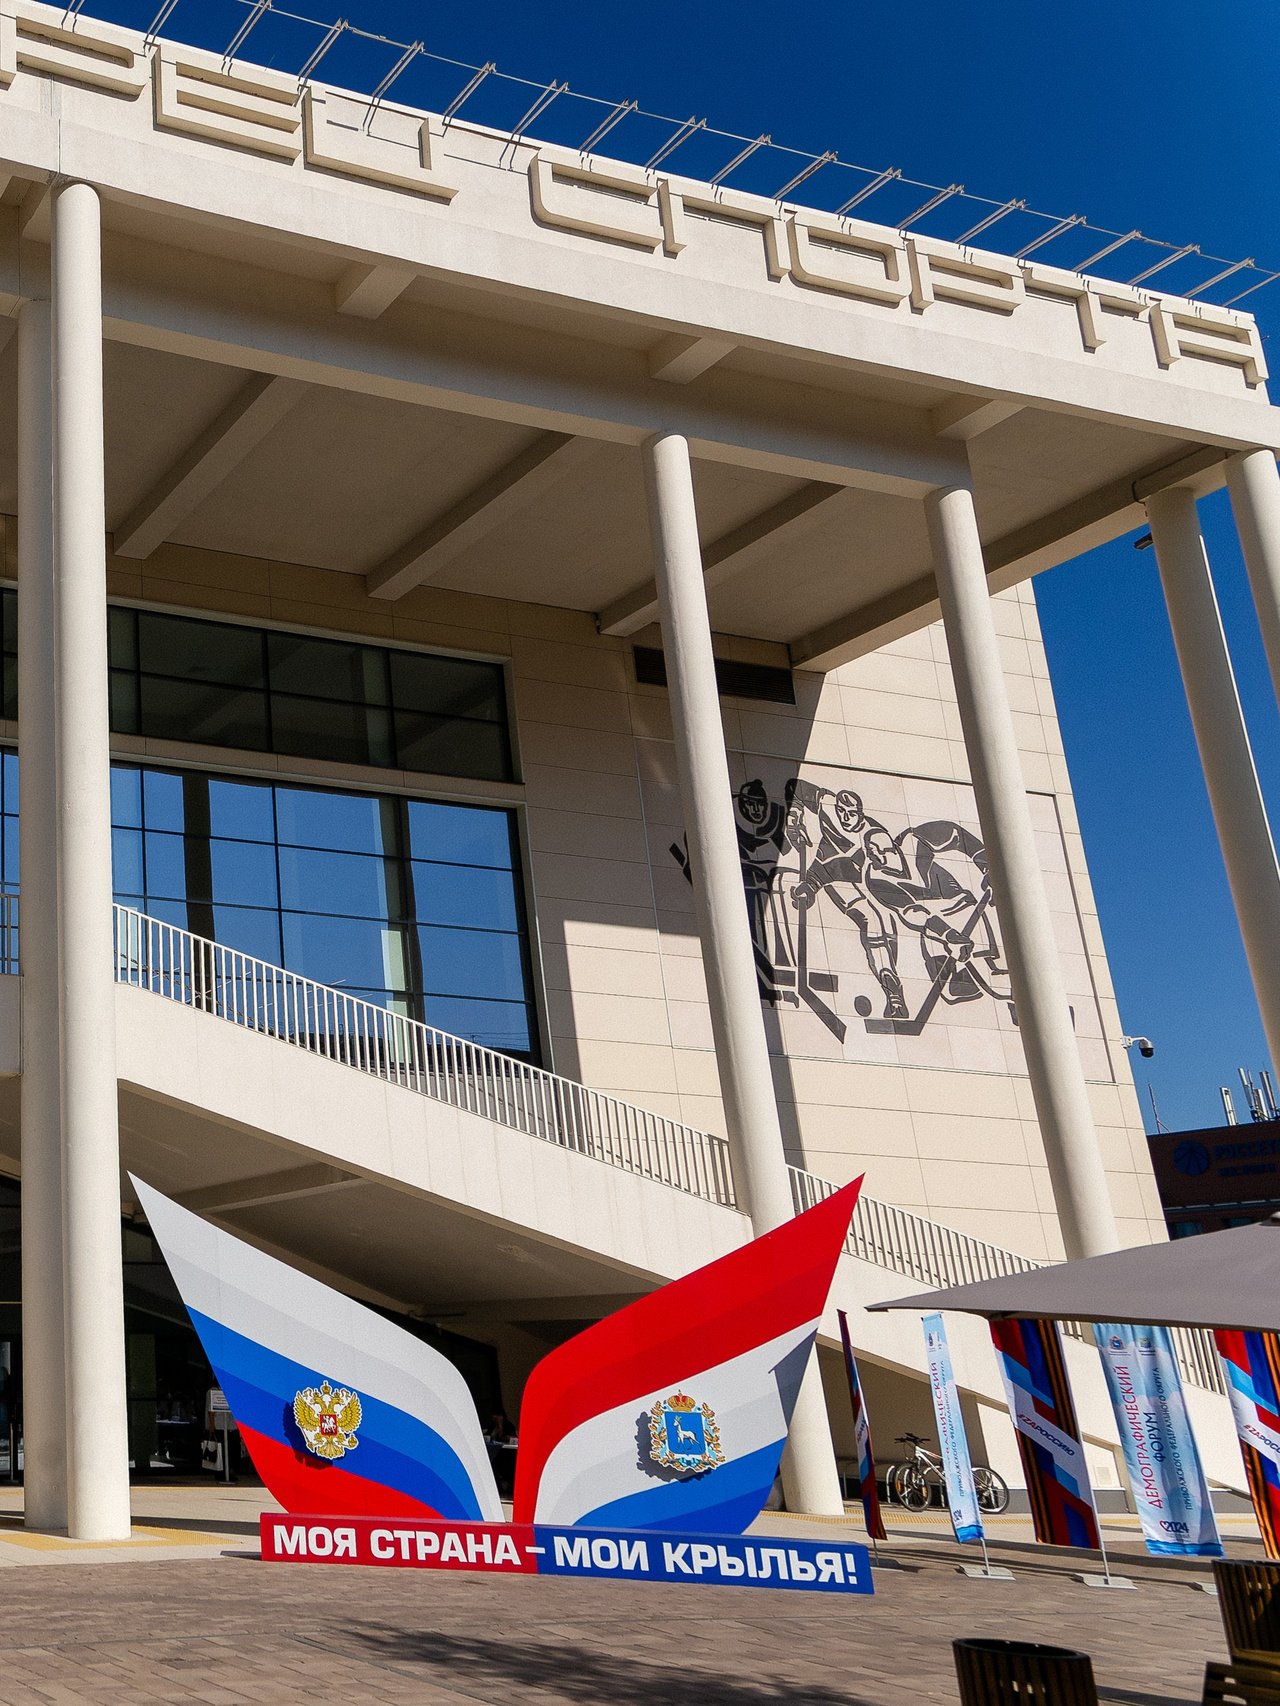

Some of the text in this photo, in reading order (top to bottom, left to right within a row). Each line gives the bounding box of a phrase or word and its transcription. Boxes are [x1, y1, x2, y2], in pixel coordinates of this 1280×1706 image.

[528, 148, 1270, 390] СПОРТА
[1112, 1366, 1163, 1509] ДЕМОГРАФИЧЕСКИЙ
[1143, 1412, 1165, 1463] ФОРУМ
[272, 1525, 357, 1559] МОЯ
[369, 1528, 521, 1565] СТРАНА
[553, 1536, 650, 1573] МОИ
[664, 1541, 858, 1585] КРЫЛЬЯ!
[1164, 1520, 1190, 1533] 2024
